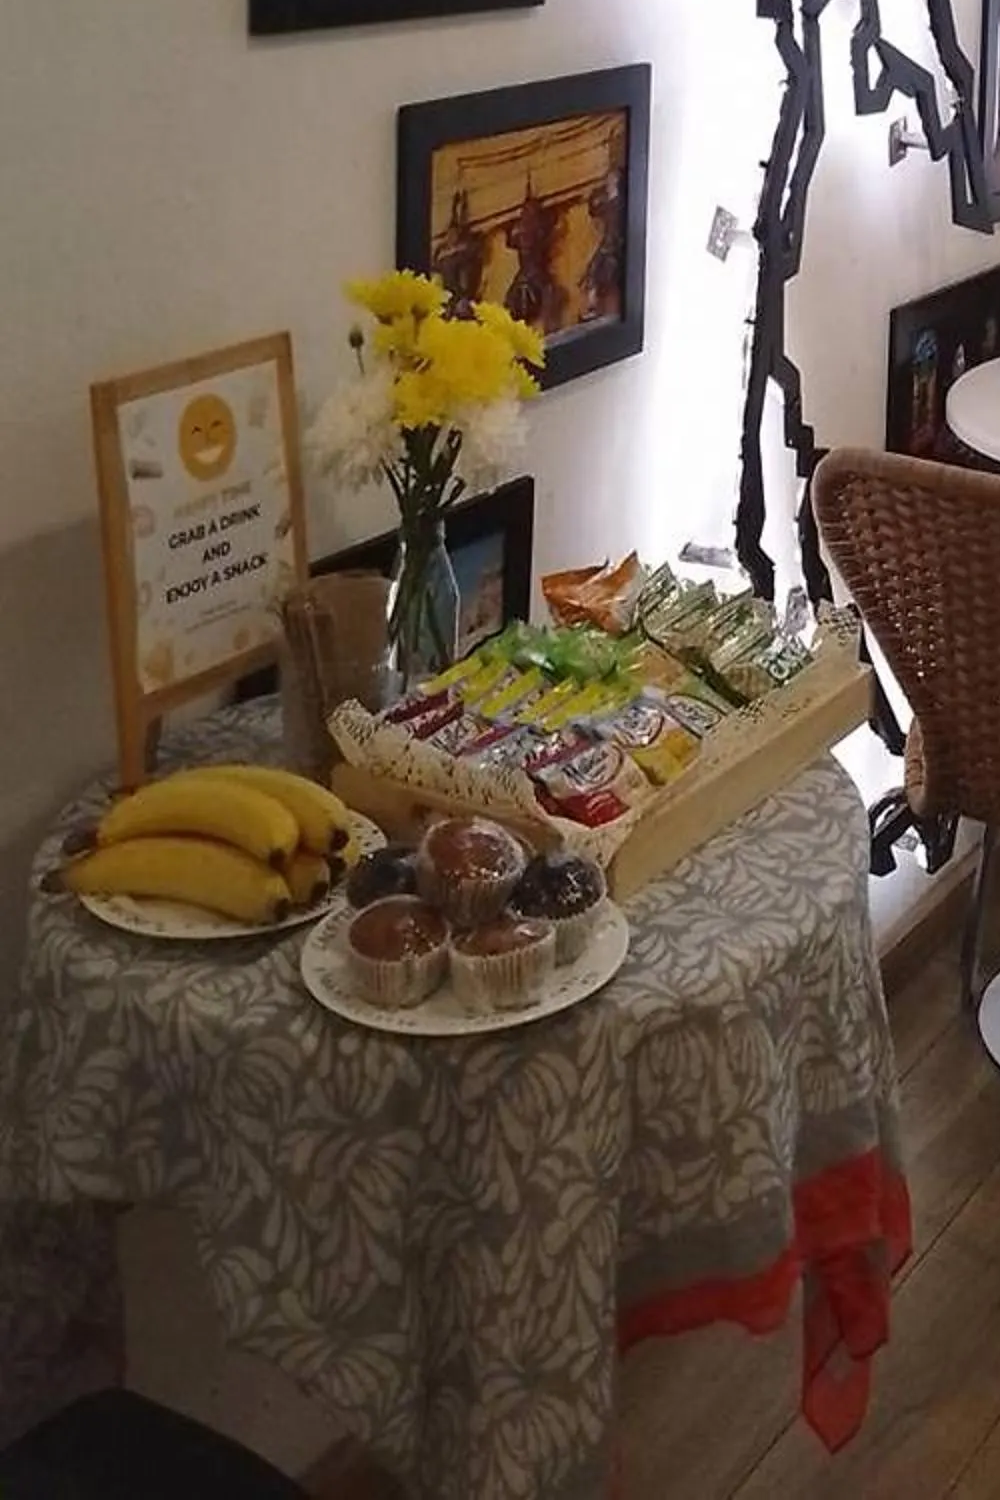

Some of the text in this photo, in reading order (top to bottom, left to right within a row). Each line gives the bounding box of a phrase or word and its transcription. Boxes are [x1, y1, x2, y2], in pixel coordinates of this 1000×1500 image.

[168, 523, 206, 549] GRAB
[208, 519, 218, 536] A
[220, 503, 262, 531] DRINK
[203, 541, 231, 563] AND
[166, 553, 268, 604] ENJOY A SNACK
